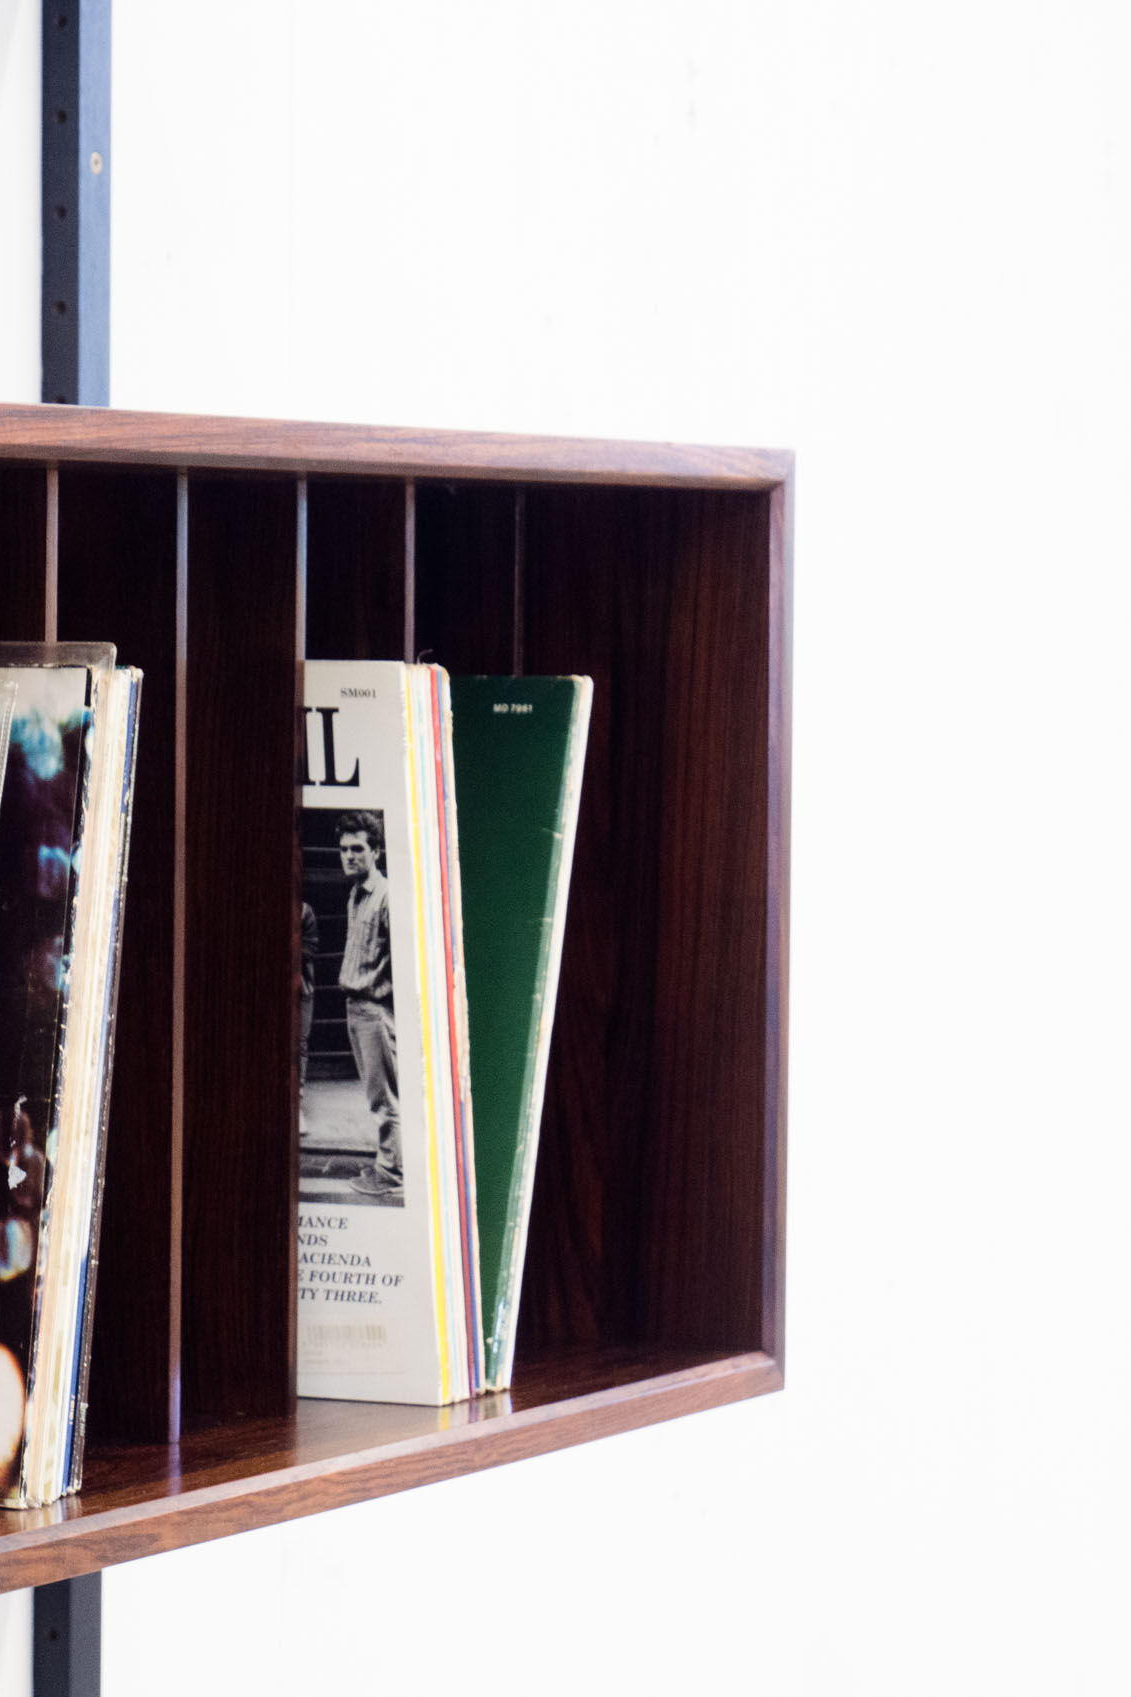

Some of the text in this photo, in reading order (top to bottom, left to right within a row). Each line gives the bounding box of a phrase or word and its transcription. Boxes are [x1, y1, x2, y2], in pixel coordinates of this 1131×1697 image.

[340, 687, 377, 699] SM001
[298, 1252, 372, 1267] ACIENDA
[309, 1270, 376, 1285] FOURTH
[381, 1274, 404, 1288] OF
